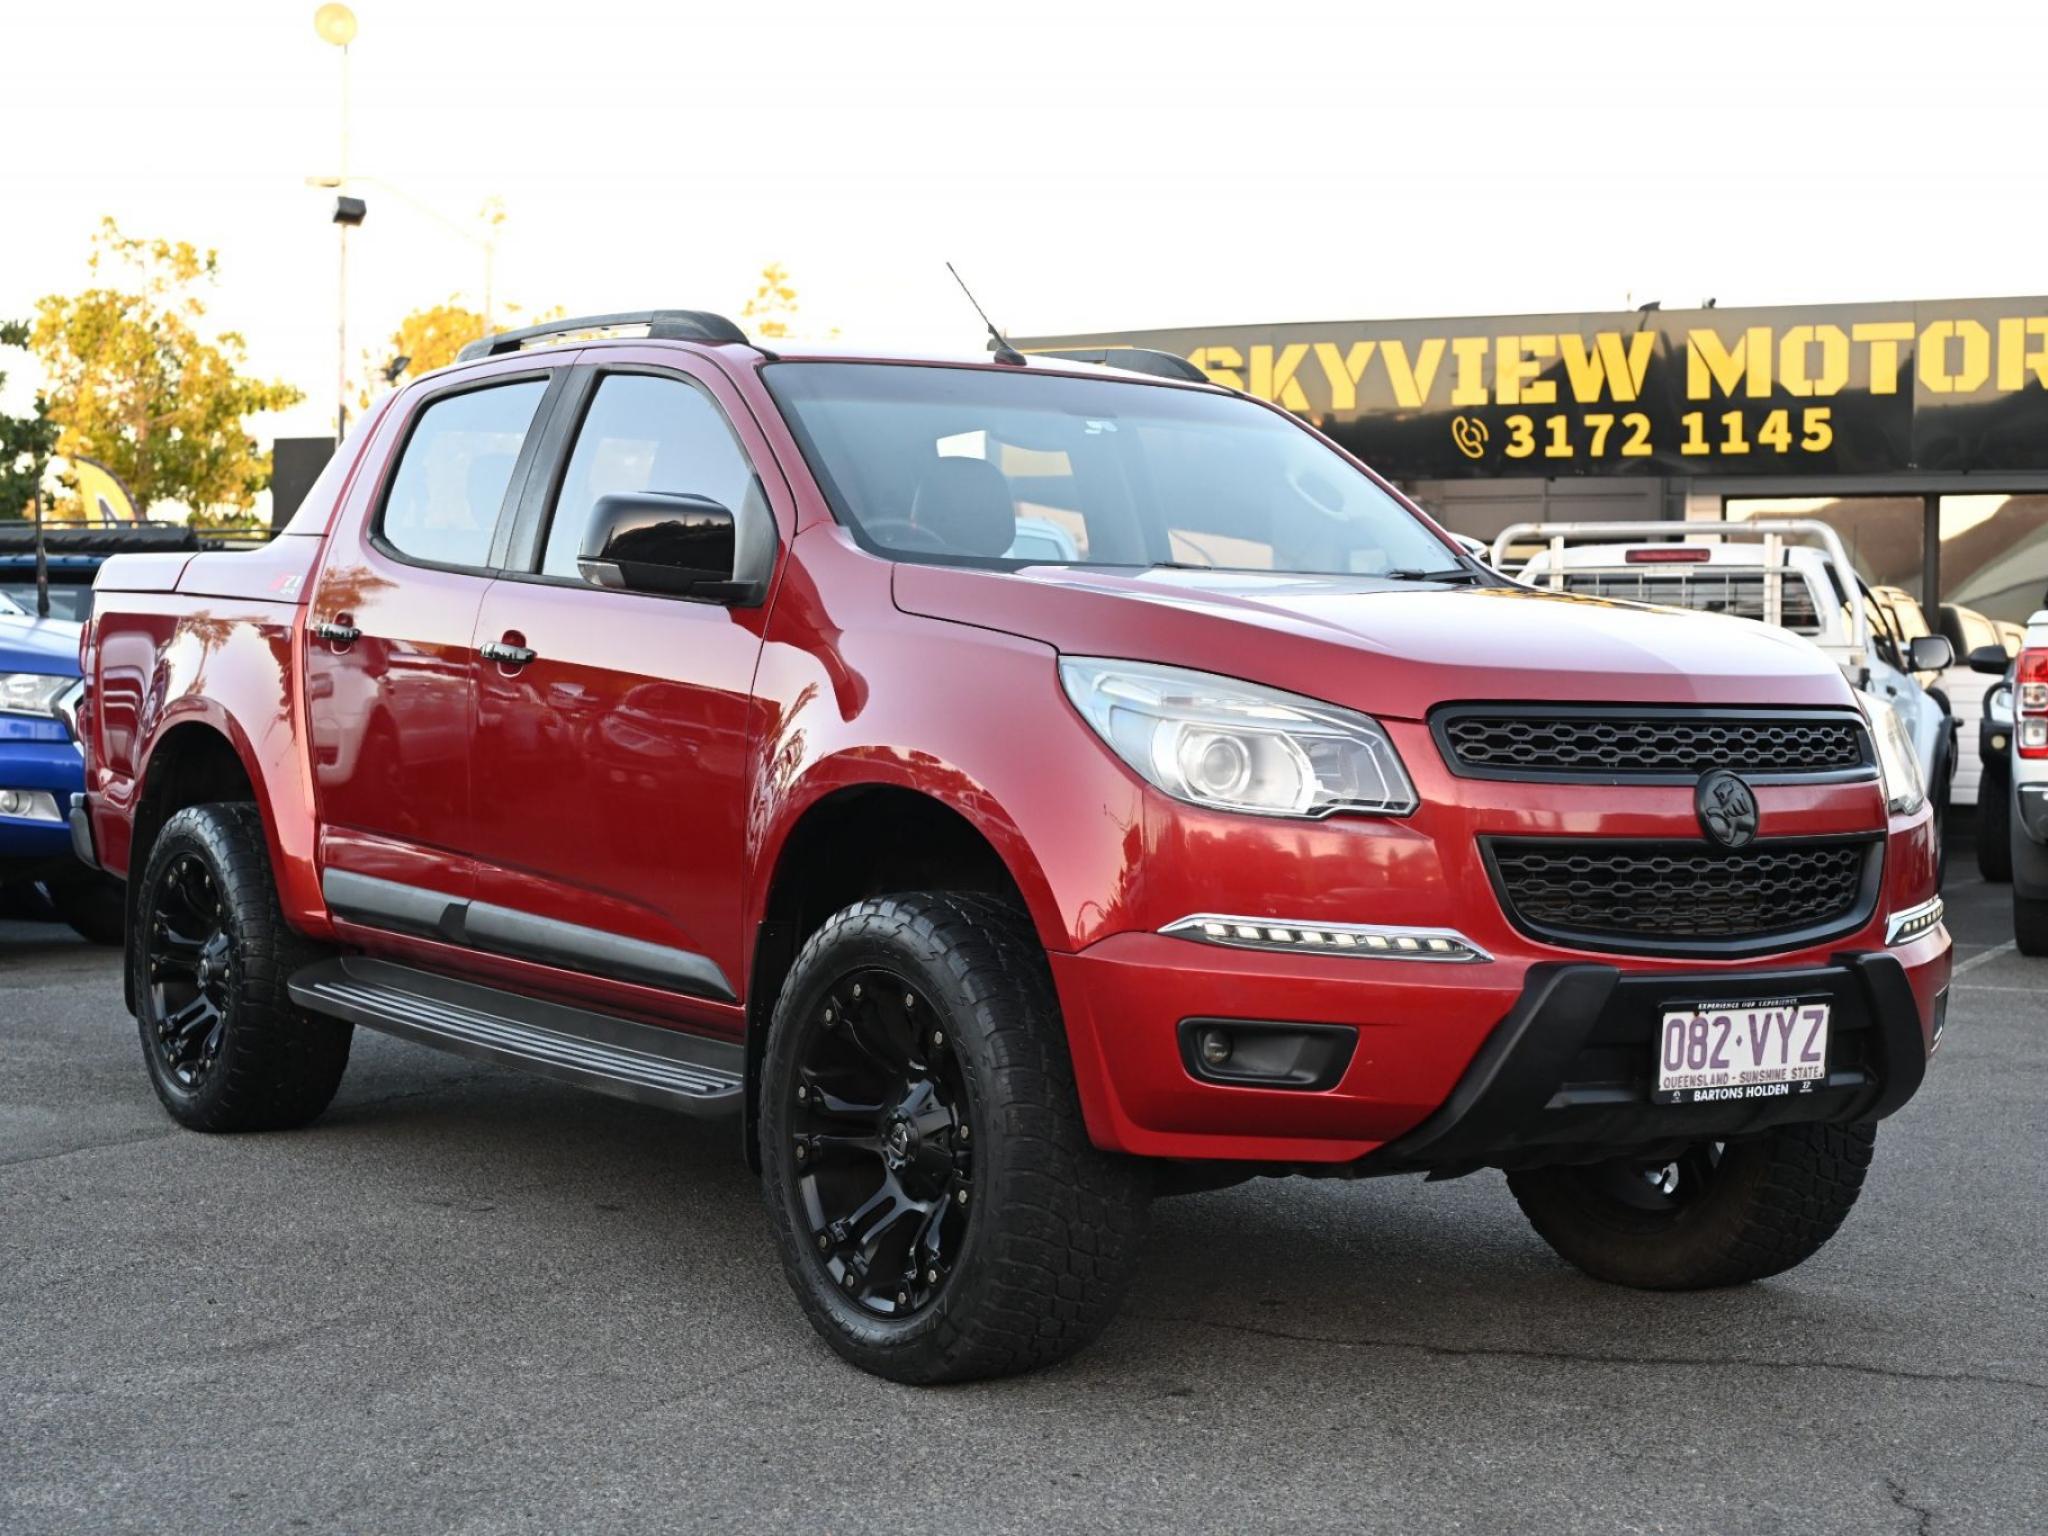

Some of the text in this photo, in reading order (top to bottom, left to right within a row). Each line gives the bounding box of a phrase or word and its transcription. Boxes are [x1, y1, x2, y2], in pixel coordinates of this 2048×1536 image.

[1187, 316, 2048, 411] SKYVIEW MOTOR
[1504, 407, 1834, 458] 3172 1145
[1663, 1072, 1729, 1089] QUEENSLAND
[1739, 1068, 1787, 1084] SUNSHINE
[1791, 1066, 1819, 1081] STATE
[1694, 1083, 1789, 1102] BARTONS HOLDEN
